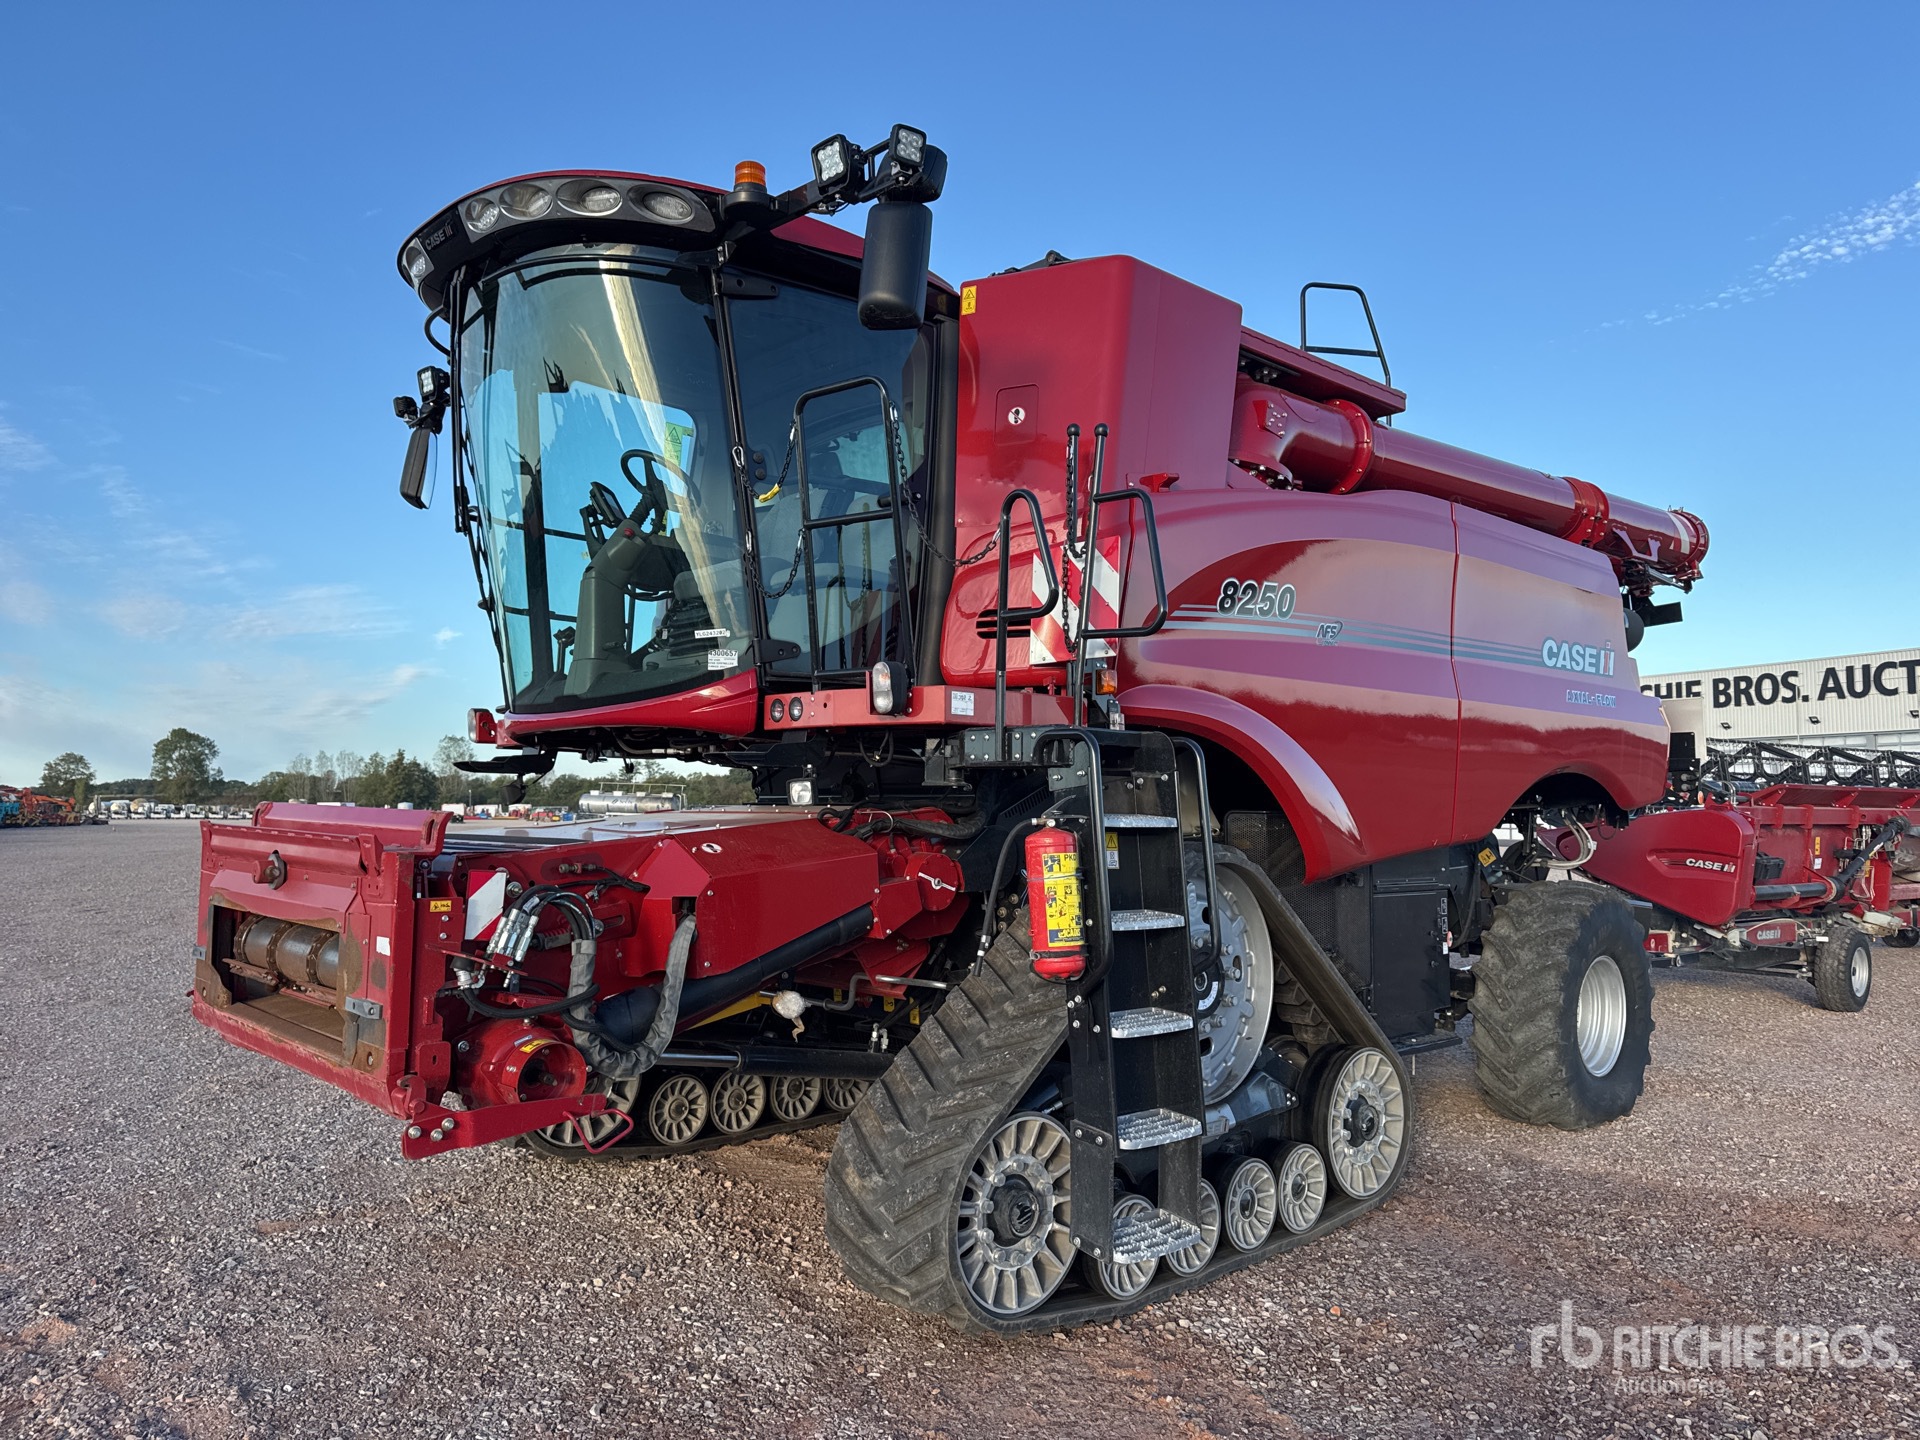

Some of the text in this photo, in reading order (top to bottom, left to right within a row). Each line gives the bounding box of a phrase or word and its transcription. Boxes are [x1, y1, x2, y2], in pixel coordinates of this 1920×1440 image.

[425, 230, 446, 250] CASE
[1217, 578, 1297, 620] 8250
[1316, 621, 1339, 640] AFS
[1542, 639, 1597, 673] CASE
[1712, 671, 1810, 708] BROS.
[1817, 659, 1920, 701] AUCT
[1686, 858, 1722, 871] CASE
[1757, 930, 1775, 940] CASE
